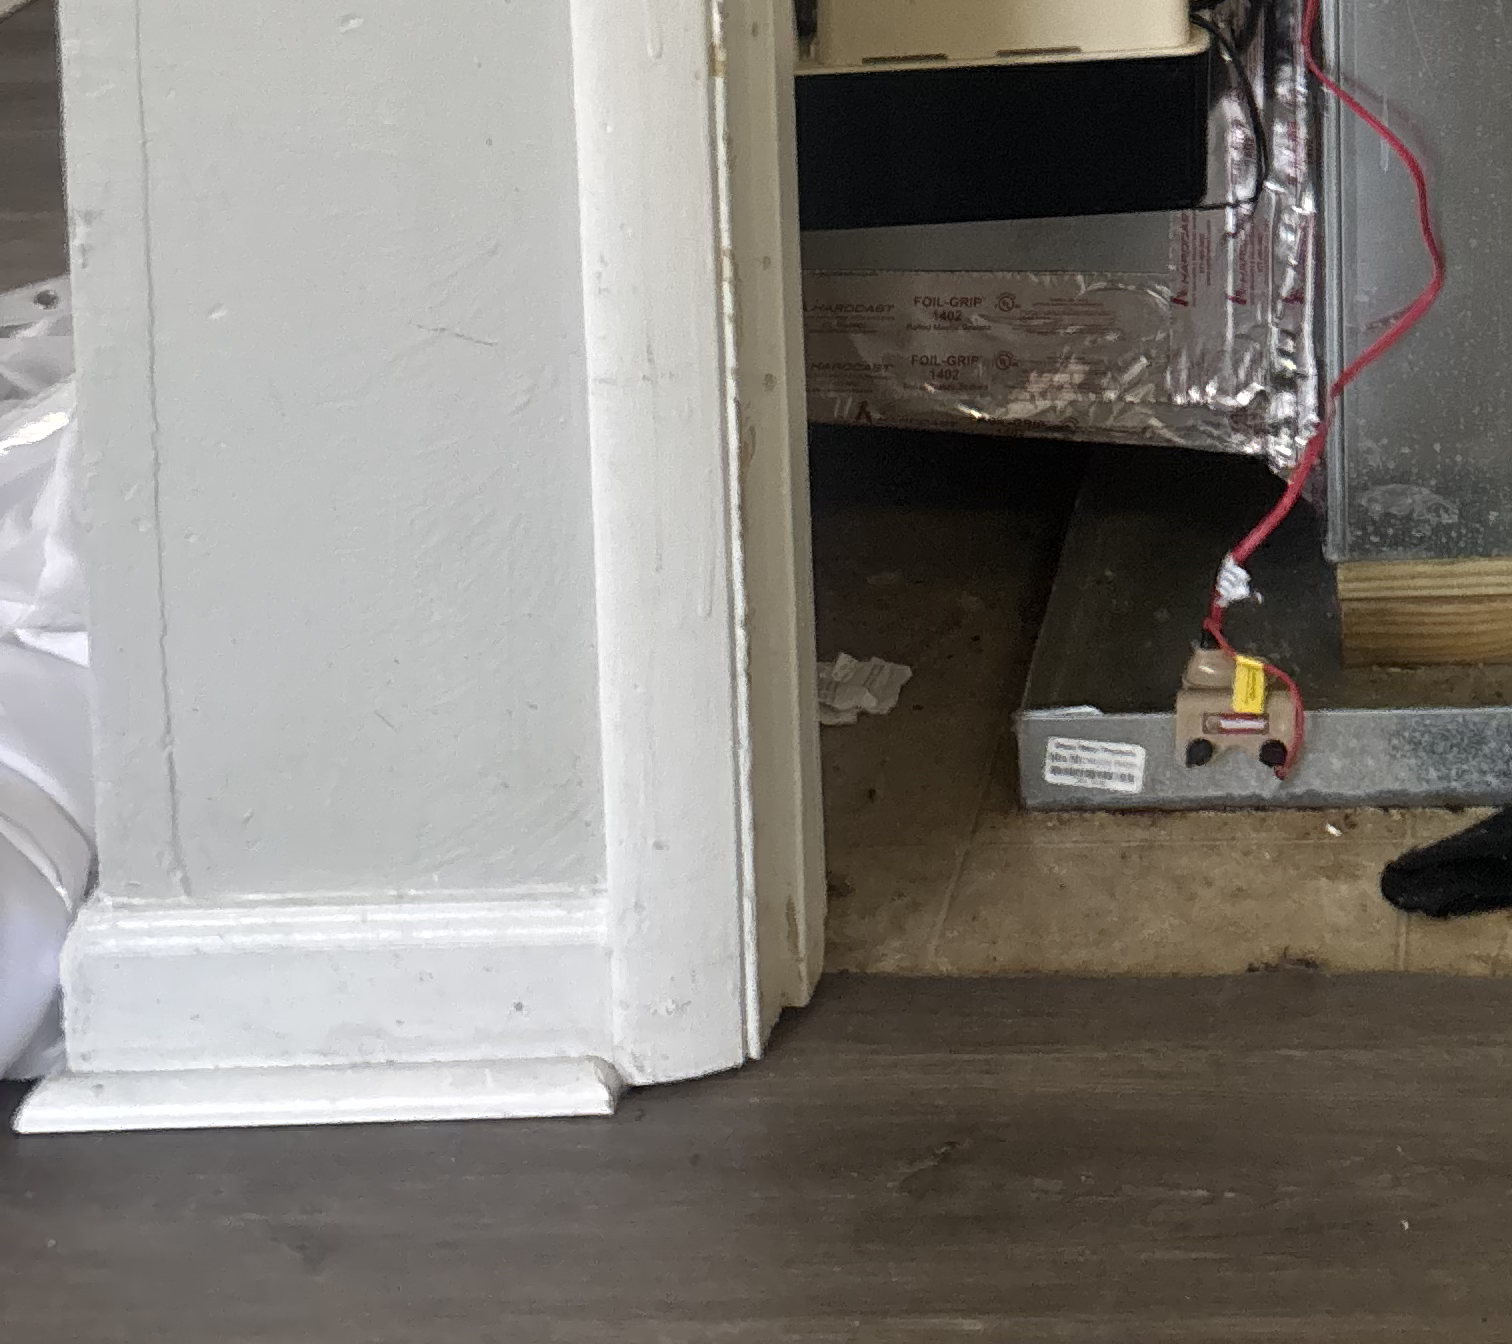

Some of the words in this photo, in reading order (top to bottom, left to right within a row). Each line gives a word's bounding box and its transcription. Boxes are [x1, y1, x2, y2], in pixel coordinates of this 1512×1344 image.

[1180, 212, 1190, 285] HARDCAS
[913, 295, 983, 309] FOIL-GRIP
[931, 309, 963, 323] 1402
[910, 353, 980, 367] FOIL-GRIP
[928, 368, 960, 381] 1402
